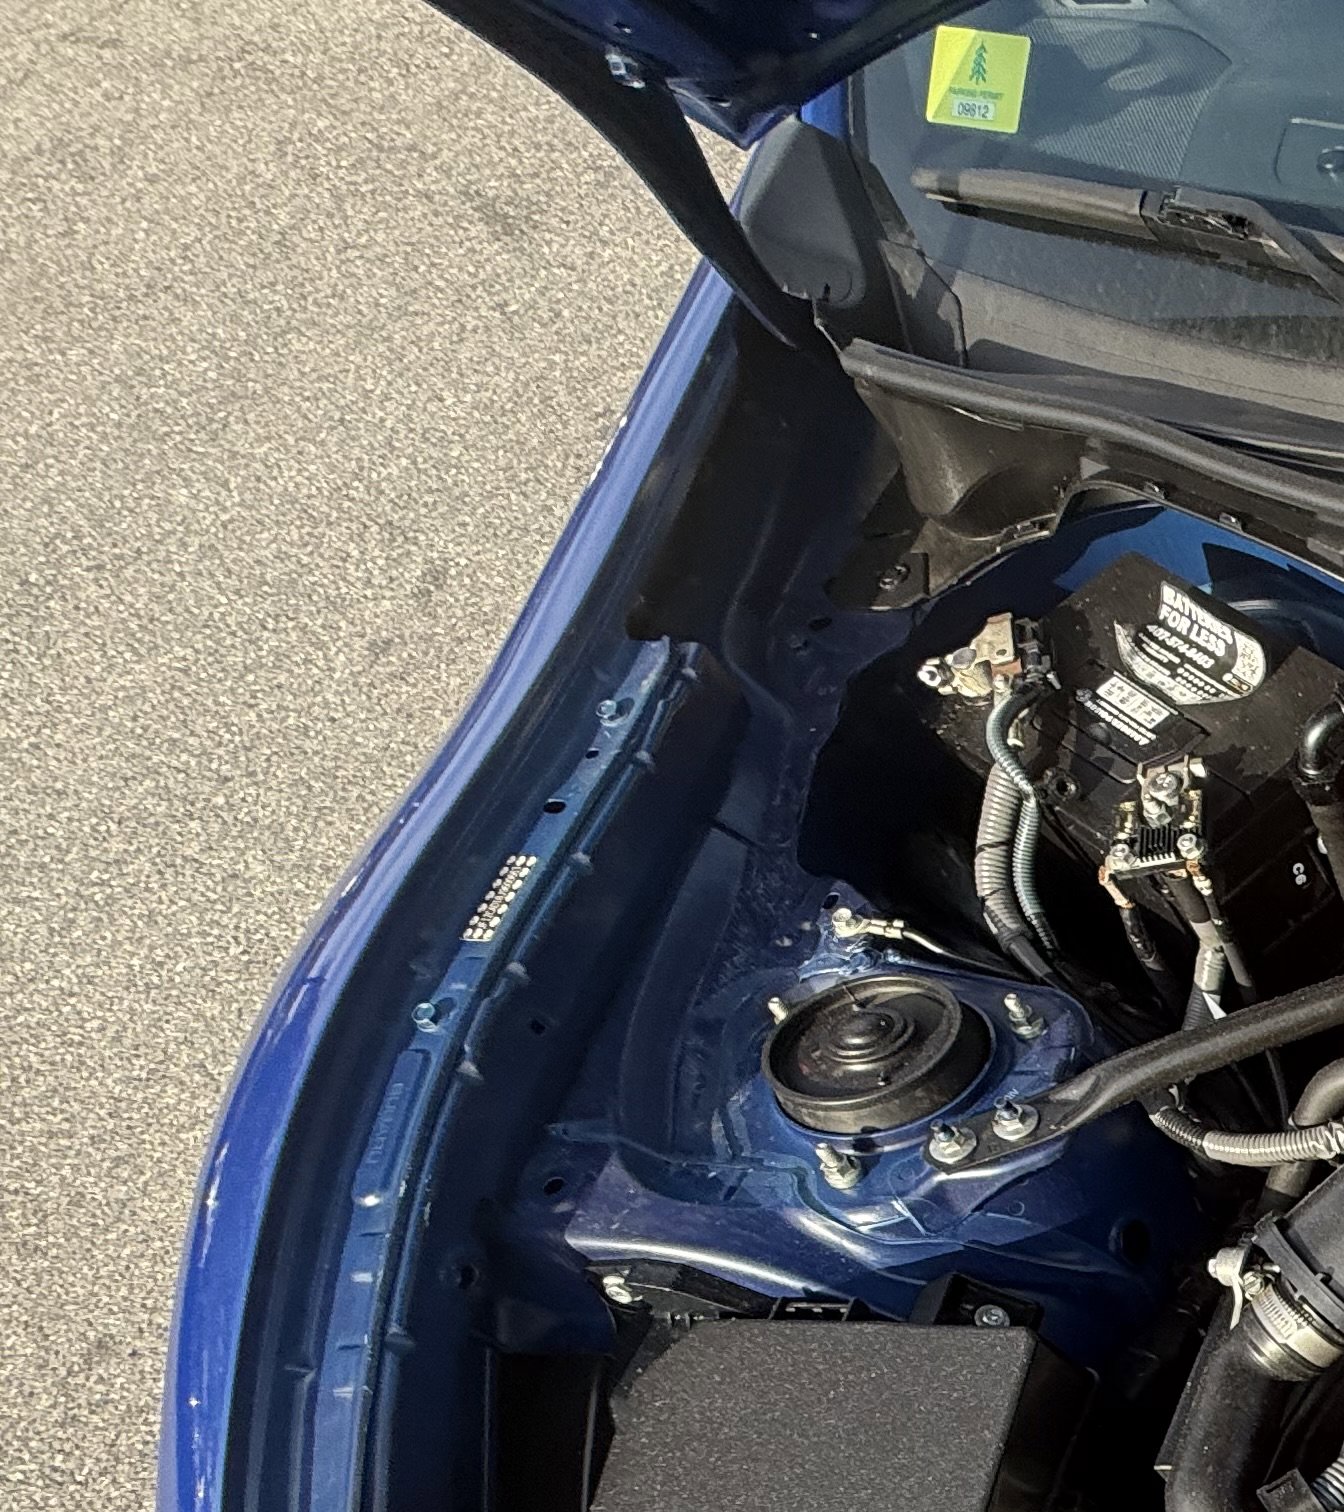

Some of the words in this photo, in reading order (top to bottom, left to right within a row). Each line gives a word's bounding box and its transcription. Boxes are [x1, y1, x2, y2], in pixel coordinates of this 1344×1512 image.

[1159, 604, 1191, 635] FOR
[1191, 622, 1227, 657] LESS
[1160, 582, 1235, 645] BATTERIES
